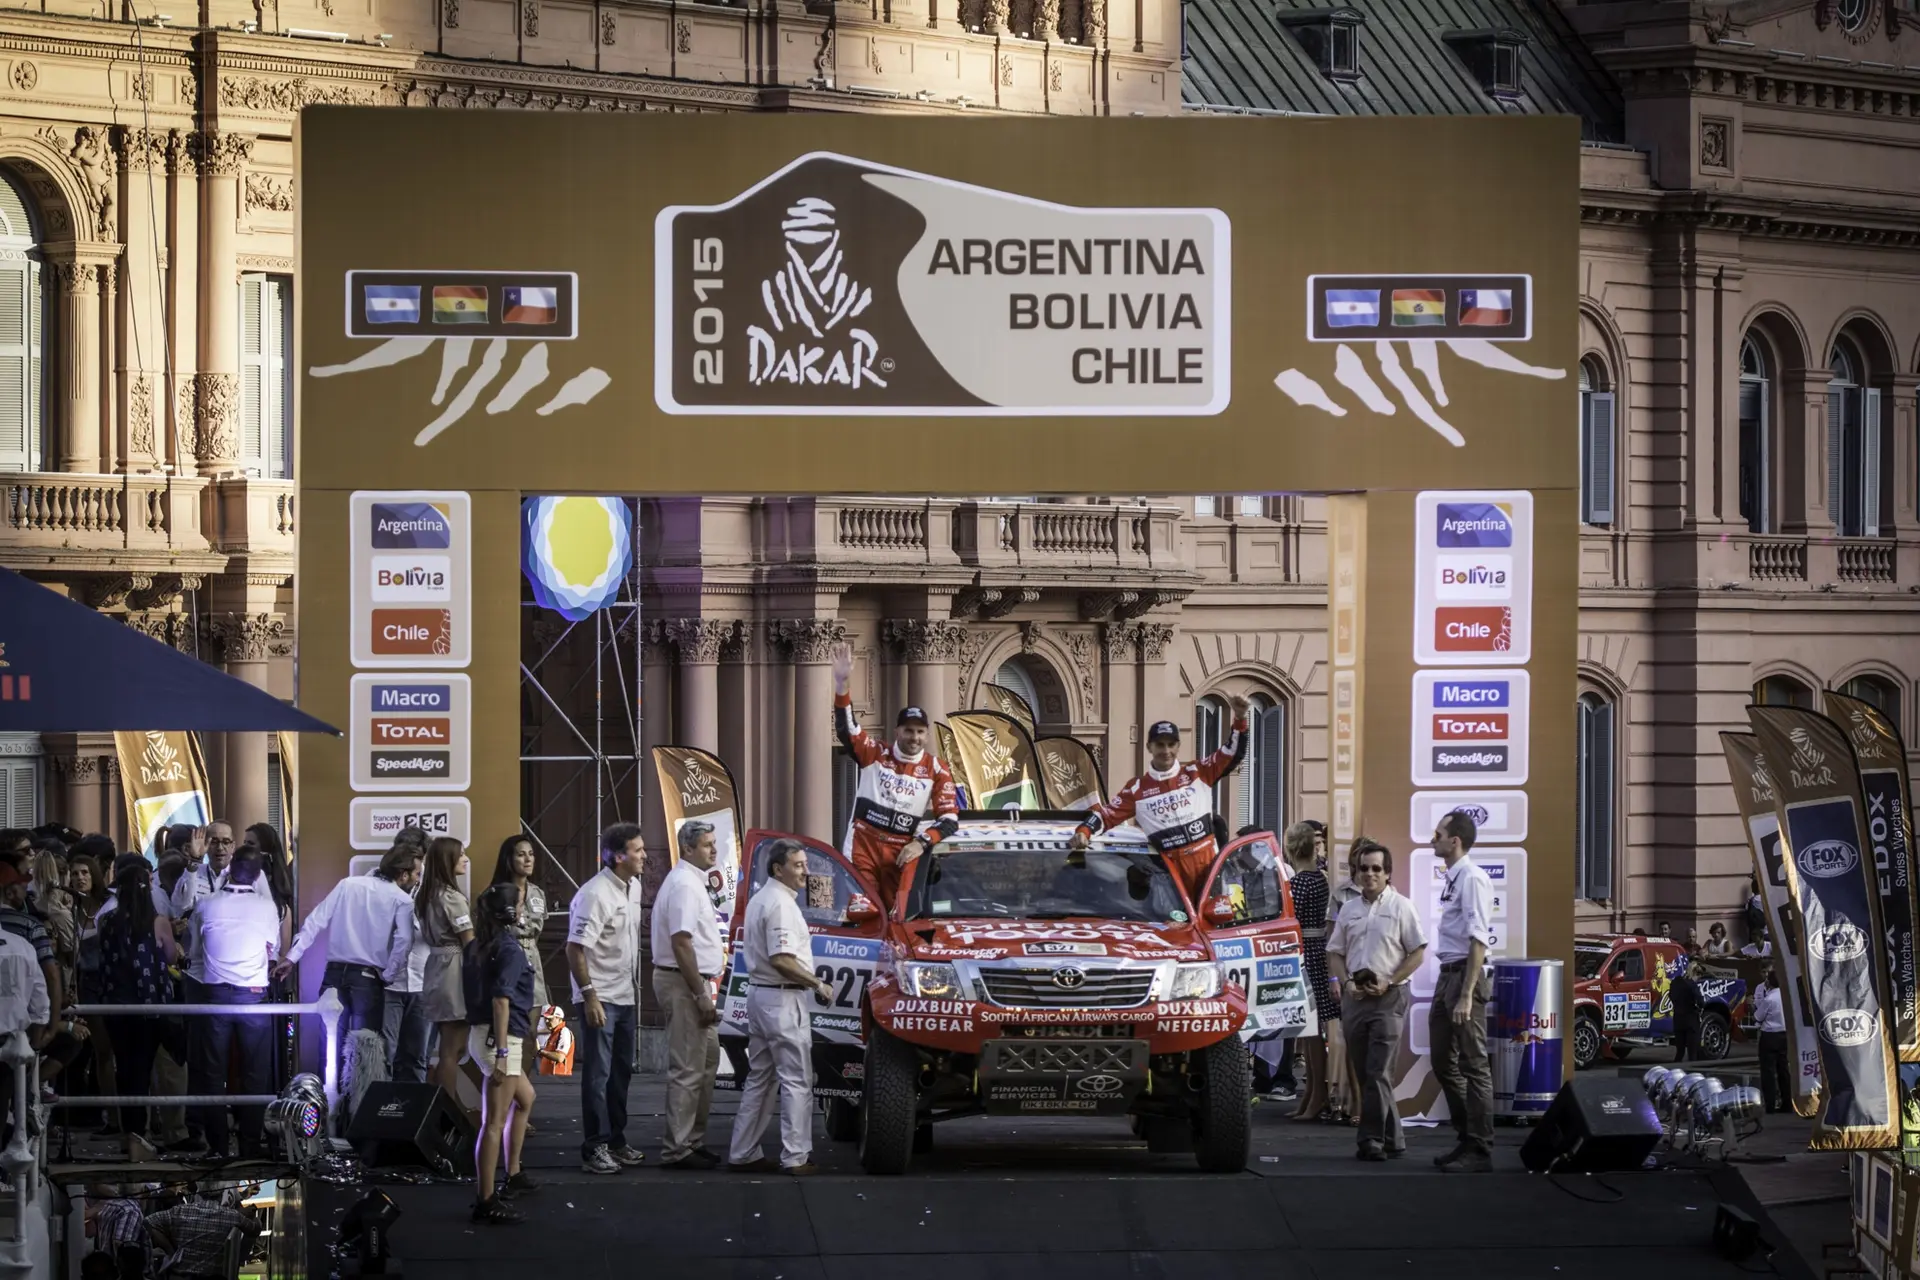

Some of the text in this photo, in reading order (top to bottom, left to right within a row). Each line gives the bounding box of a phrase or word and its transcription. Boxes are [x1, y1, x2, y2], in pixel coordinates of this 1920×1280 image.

[927, 239, 1205, 275] ARGENTINA
[693, 236, 724, 385] 2015
[1009, 293, 1203, 330] BOLIVIA
[746, 325, 887, 389] DAKAR
[1071, 348, 1203, 384] CHILE
[378, 518, 443, 535] Argentina
[1442, 518, 1506, 534] Argentina
[383, 624, 429, 641] Chile
[1446, 622, 1491, 639] Chile
[381, 689, 441, 706] Macro
[1442, 686, 1500, 702] Macro
[377, 723, 444, 738] TOTAL
[1438, 719, 1503, 733] TOTAL
[376, 758, 444, 771] SpeedAgro
[1437, 753, 1503, 765] SpeedAgro
[141, 762, 187, 784] DAKAR
[982, 758, 1020, 780] DAKAR
[1790, 765, 1836, 788] DAKAR
[878, 770, 919, 790] IMPERIAL
[880, 779, 915, 796] TOYOTA
[681, 786, 721, 808] DAKAR
[1146, 791, 1191, 811] IMPERIAL
[1752, 787, 1774, 803] DAK
[1152, 799, 1191, 816] TOYOTA
[373, 821, 401, 831] sport
[422, 816, 433, 829] 3
[436, 816, 447, 829] 4
[1004, 841, 1070, 850] HILU
[1869, 792, 1891, 896] EDOX
[1811, 848, 1845, 864] FOX
[1812, 861, 1847, 872] SPORTS
[1895, 852, 1907, 887] Swiss
[945, 922, 1155, 935] IMPERIAL
[950, 929, 1174, 948] TOYOTA
[1823, 931, 1856, 947] FOX
[824, 940, 868, 957] Macro
[930, 947, 1008, 956] innovation
[1214, 944, 1244, 957] Macro
[1263, 963, 1293, 978] Macro
[1901, 931, 1914, 1020] Swiss Watches
[1261, 987, 1299, 1002] SpeedAgro
[895, 1000, 976, 1015] DUXBURY
[1157, 1001, 1228, 1016] DUXBURY
[1605, 1005, 1626, 1022] 331
[813, 1015, 862, 1029] SpeedAgr
[893, 1017, 974, 1032] NETGEAR
[981, 1011, 1155, 1023] SOUTH AFRICAN AIRWAYS CARGO
[1529, 1012, 1558, 1029] Bull
[1831, 1016, 1865, 1032] FOX
[1157, 1019, 1230, 1033] NETGEAR
[1831, 1028, 1867, 1040] SPORTS
[990, 1092, 1057, 1100] SERVICES
